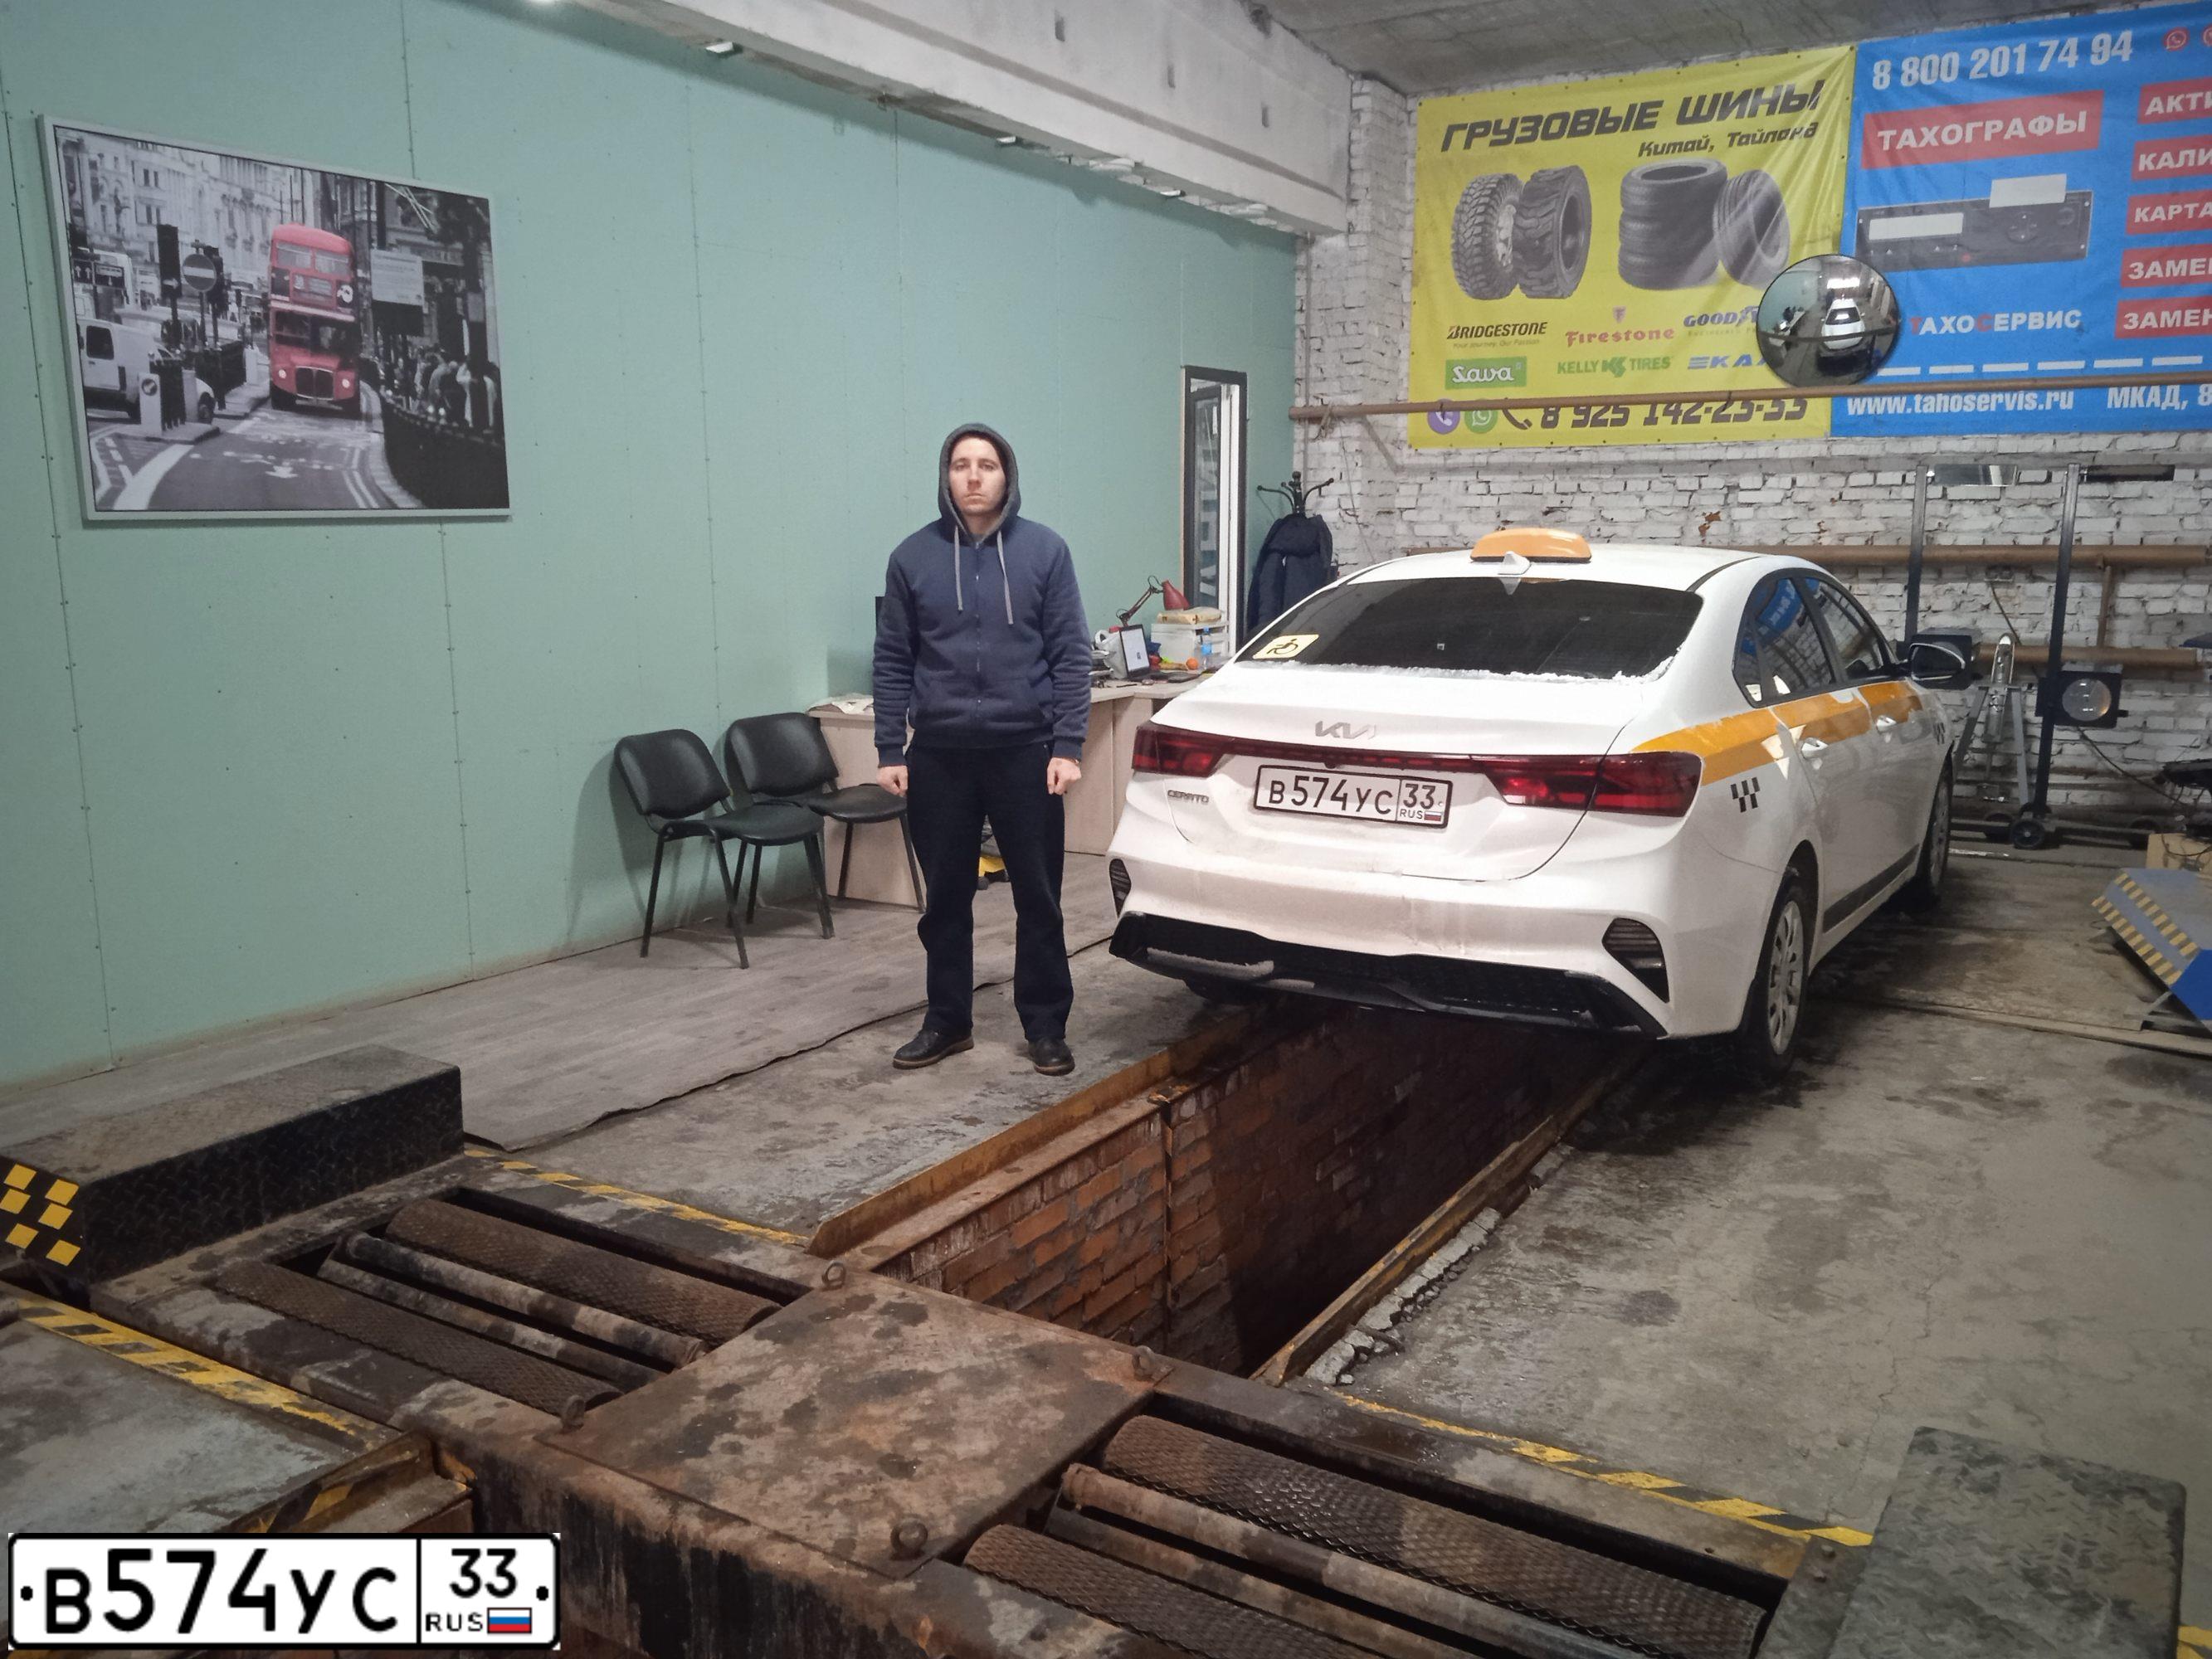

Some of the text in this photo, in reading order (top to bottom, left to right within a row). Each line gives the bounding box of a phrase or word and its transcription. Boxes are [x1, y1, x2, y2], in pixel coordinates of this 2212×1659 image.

[1872, 30, 2133, 90] 8 800 201 74 94
[1441, 80, 1825, 153] ГРУЗОВЫЕ ШИНЫ
[1878, 111, 2088, 151] ТАХОГРАФЫ
[1638, 134, 1715, 158] Китай,
[2128, 258, 2212, 280] ЗАМЕ
[1447, 322, 1547, 339] BRIDGESTONE
[1910, 309, 2082, 336] ТАХОСЕРВИС
[1566, 328, 1674, 348] Firestone
[1452, 366, 1514, 383] Sava
[1557, 357, 1672, 374] KELLY TIRES
[1847, 390, 2074, 416] www.tahoservis.ru
[2107, 384, 2189, 411] МКАД,
[1541, 405, 1561, 429] 8
[1571, 404, 1630, 428] 925
[1269, 775, 1436, 815] В574УС 33
[1400, 808, 1424, 820] RUS
